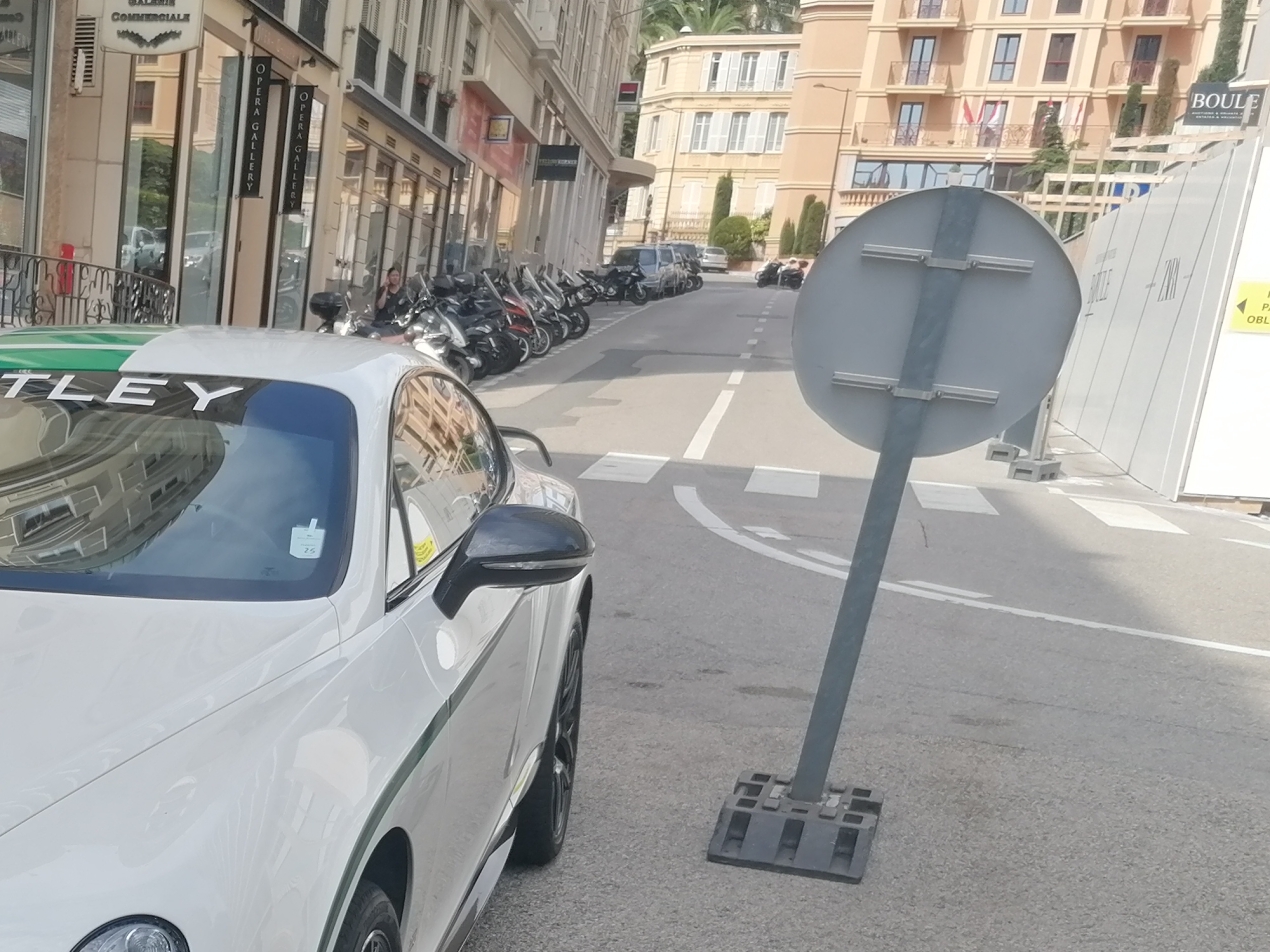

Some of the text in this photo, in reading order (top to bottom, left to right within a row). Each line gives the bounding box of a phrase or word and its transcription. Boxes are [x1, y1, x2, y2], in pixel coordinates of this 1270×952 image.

[111, 12, 190, 22] COMMERCIALE
[247, 63, 266, 192] OPERA GALLERY
[1191, 93, 1260, 109] BOULE
[290, 91, 309, 208] OPERA GALLERY
